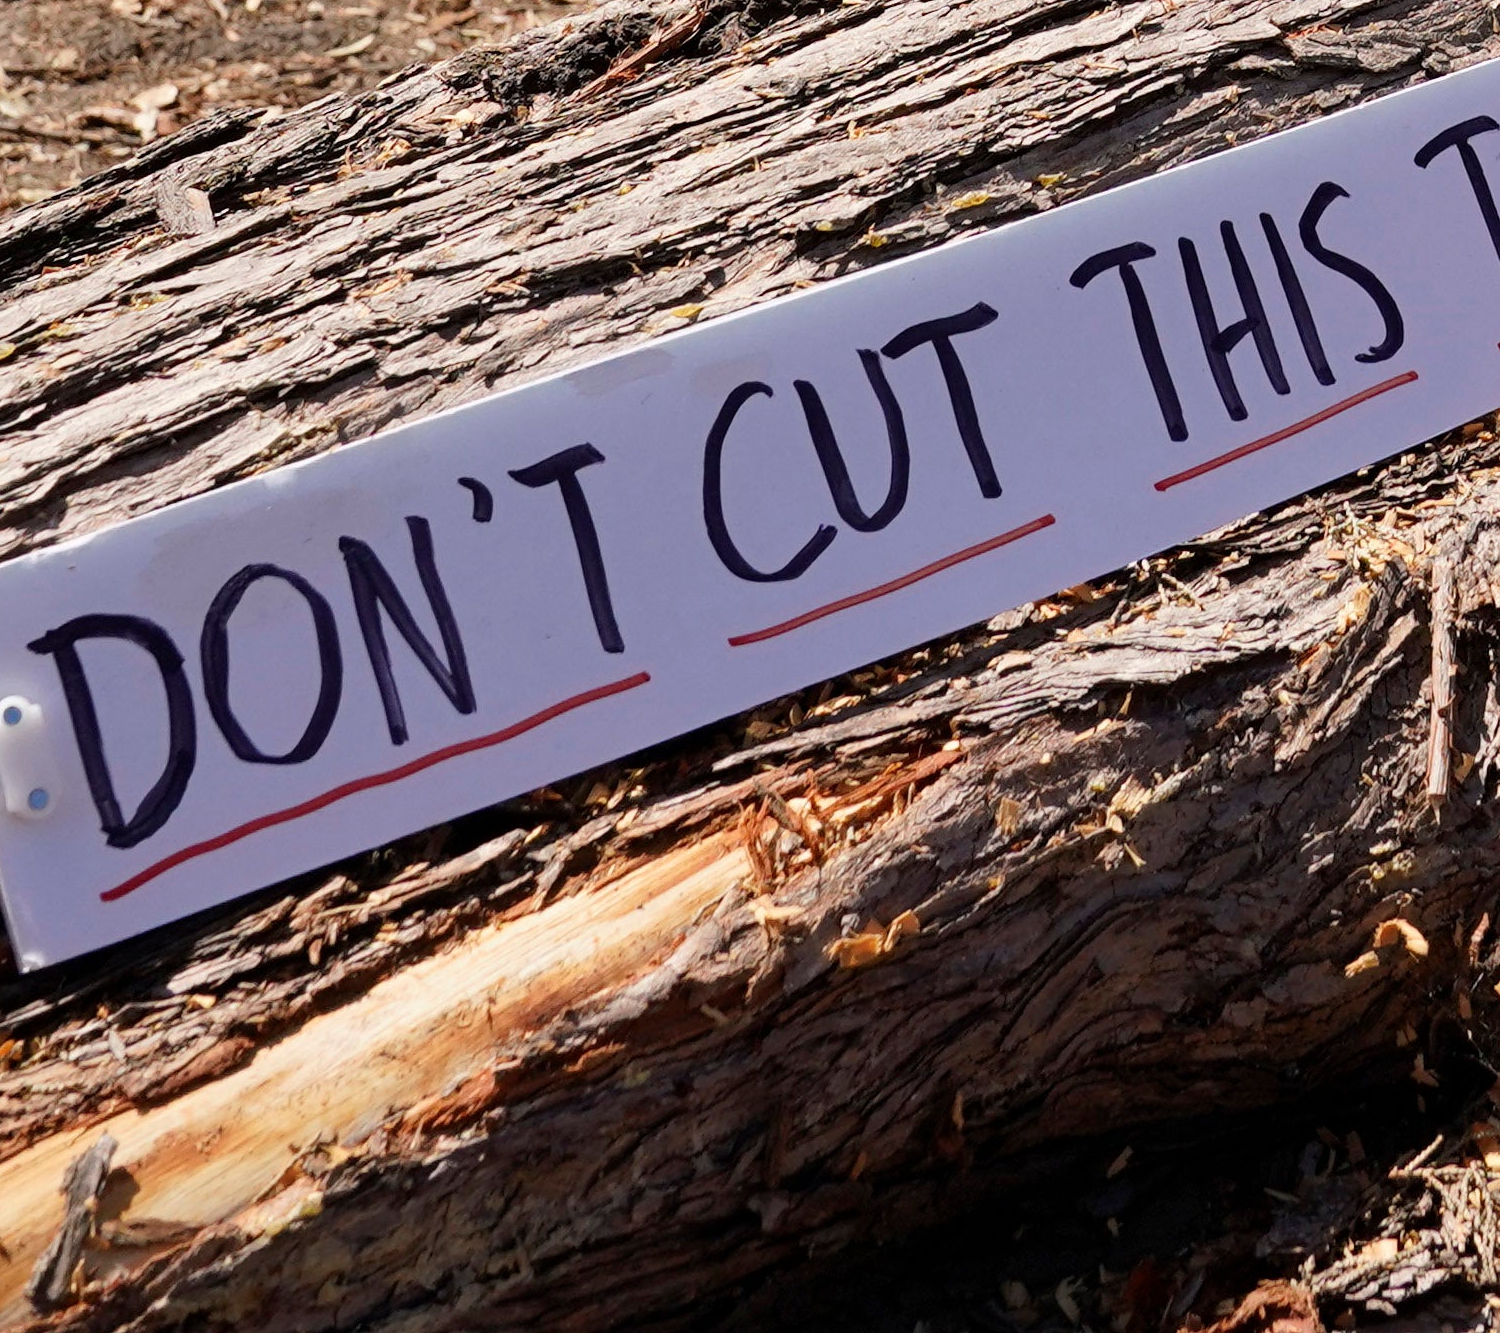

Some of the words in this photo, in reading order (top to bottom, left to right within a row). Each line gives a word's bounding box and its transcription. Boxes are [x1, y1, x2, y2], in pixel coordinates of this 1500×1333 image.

[28, 442, 625, 849] DON'T
[702, 301, 1003, 583] CUT
[1069, 181, 1406, 443] THIS
